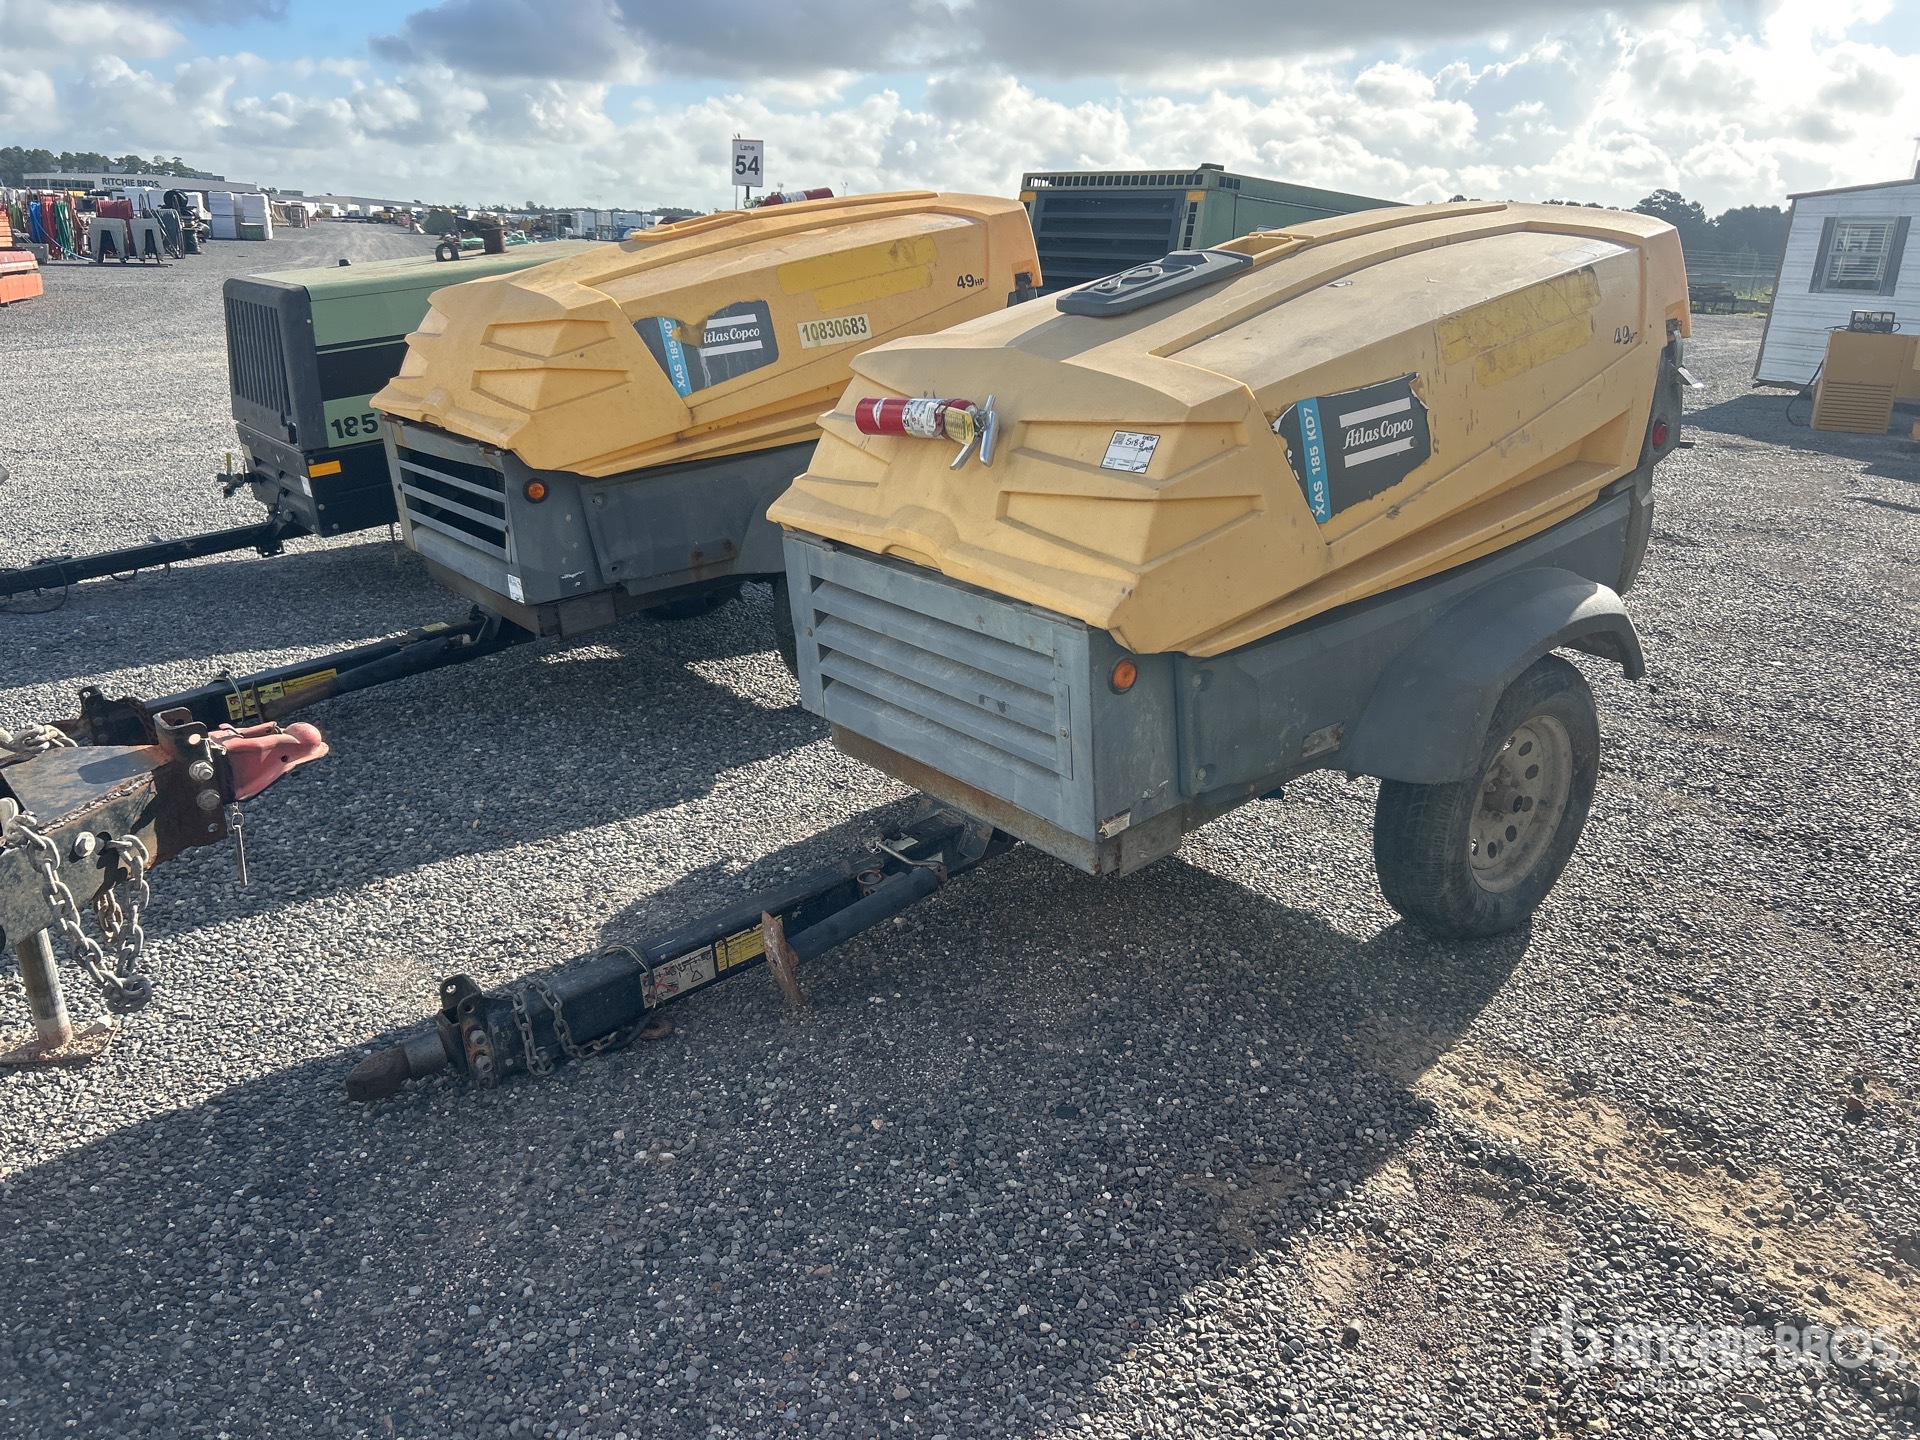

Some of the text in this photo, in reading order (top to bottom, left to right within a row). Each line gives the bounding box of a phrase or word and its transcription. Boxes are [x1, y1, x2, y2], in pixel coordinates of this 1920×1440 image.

[739, 143, 756, 151] Lane
[735, 154, 760, 176] 54
[101, 177, 136, 187] RITCHIE
[729, 327, 760, 341] Copco
[802, 316, 867, 342] 10830683
[662, 317, 687, 389] XAS 185 KD
[331, 412, 379, 439] 185
[1342, 418, 1414, 450] Atlas Copco
[1303, 407, 1326, 517] XAS 185 KD7
